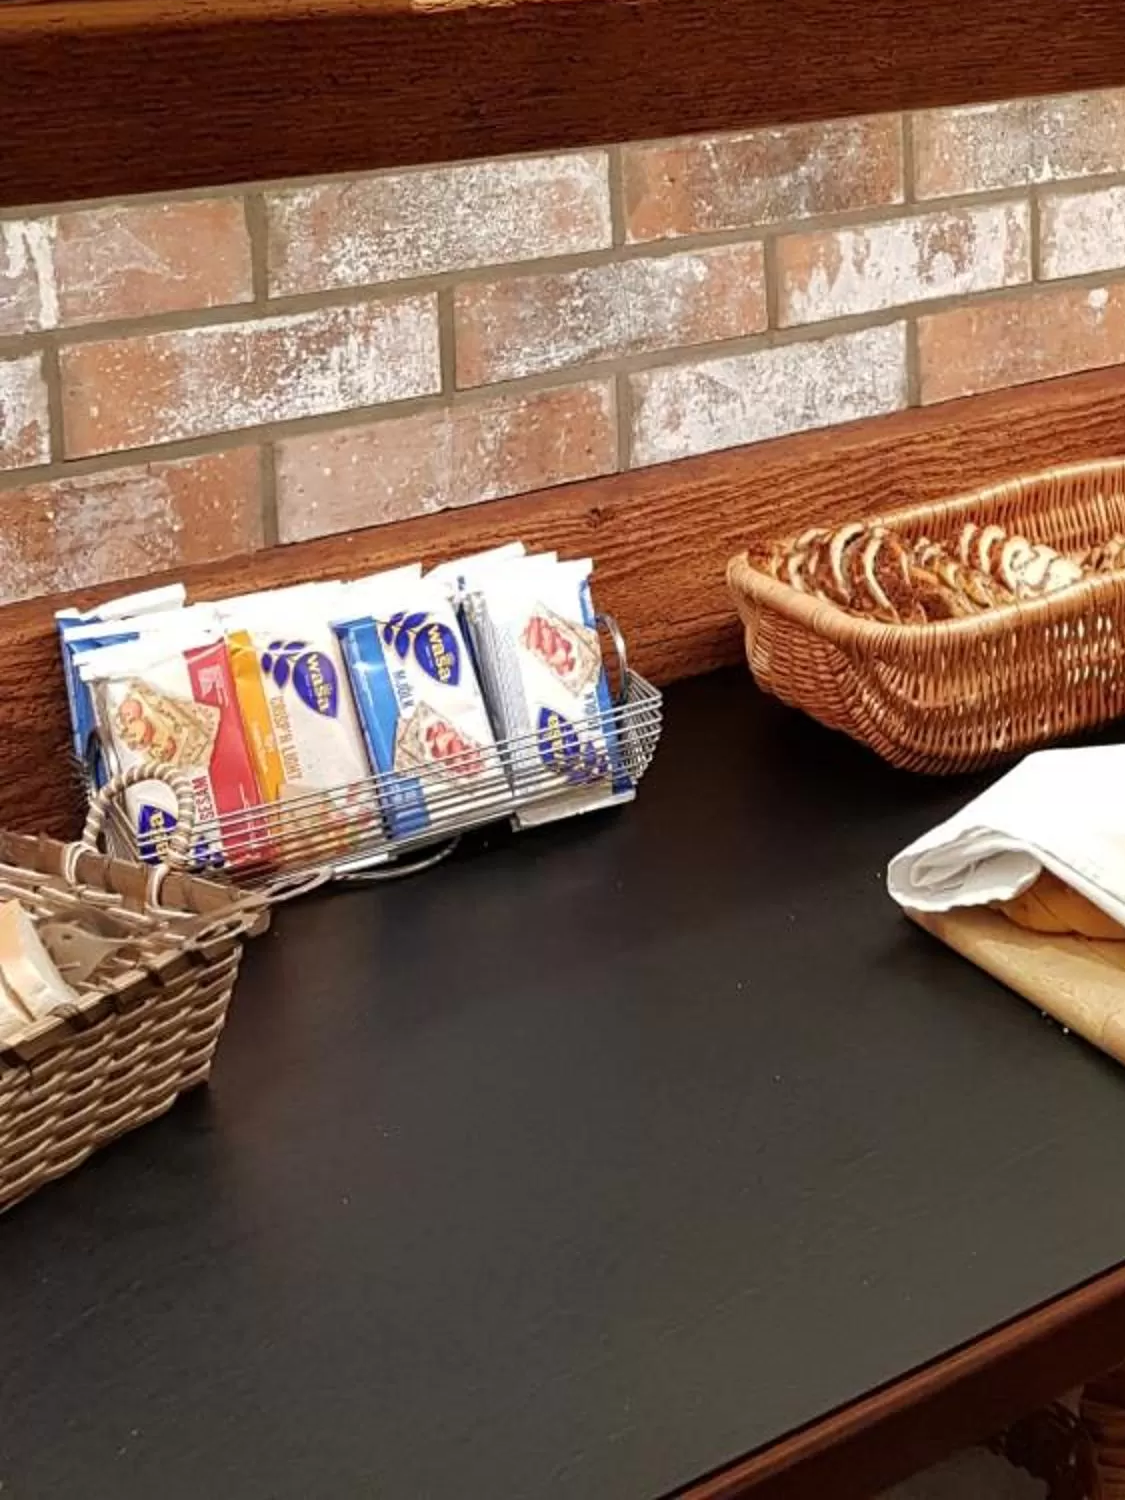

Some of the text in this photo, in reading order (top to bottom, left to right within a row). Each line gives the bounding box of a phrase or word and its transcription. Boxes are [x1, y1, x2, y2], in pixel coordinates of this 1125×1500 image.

[307, 653, 332, 712] wasa
[428, 624, 455, 684] wasa
[192, 775, 215, 820] SESAM
